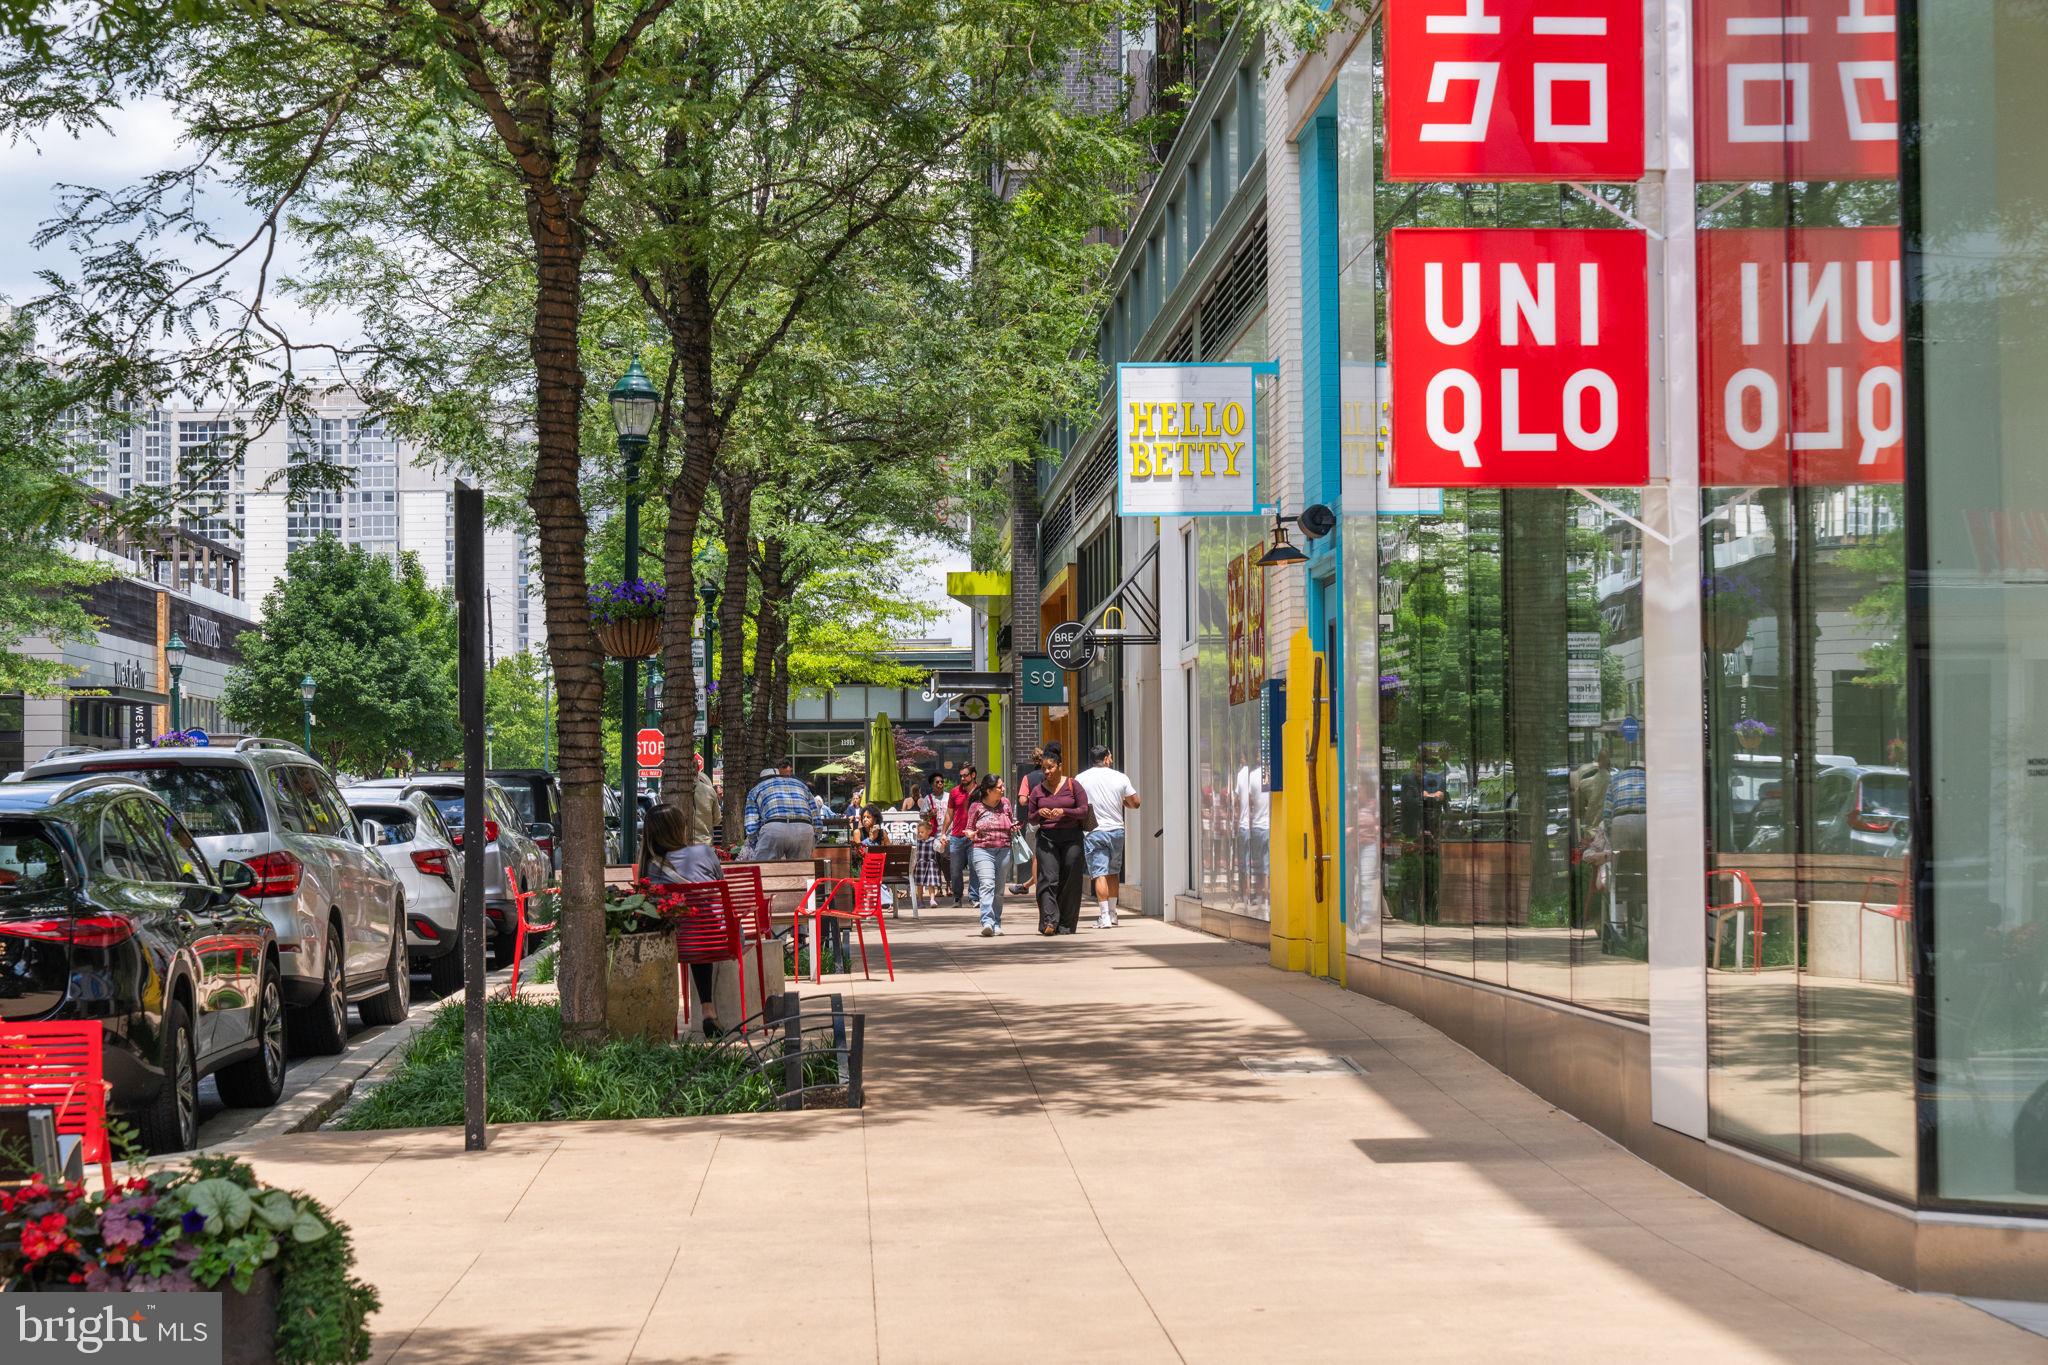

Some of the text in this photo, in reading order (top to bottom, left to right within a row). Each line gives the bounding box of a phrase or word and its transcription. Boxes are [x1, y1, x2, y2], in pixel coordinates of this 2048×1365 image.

[1425, 263, 1599, 346] UNI
[1130, 402, 1245, 437] HELLO
[1425, 368, 1619, 468] QLO
[1130, 442, 1245, 477] BETTY
[114, 659, 146, 689] west elm
[1030, 671, 1056, 688] sg
[136, 706, 144, 733] west
[637, 741, 665, 755] STOP
